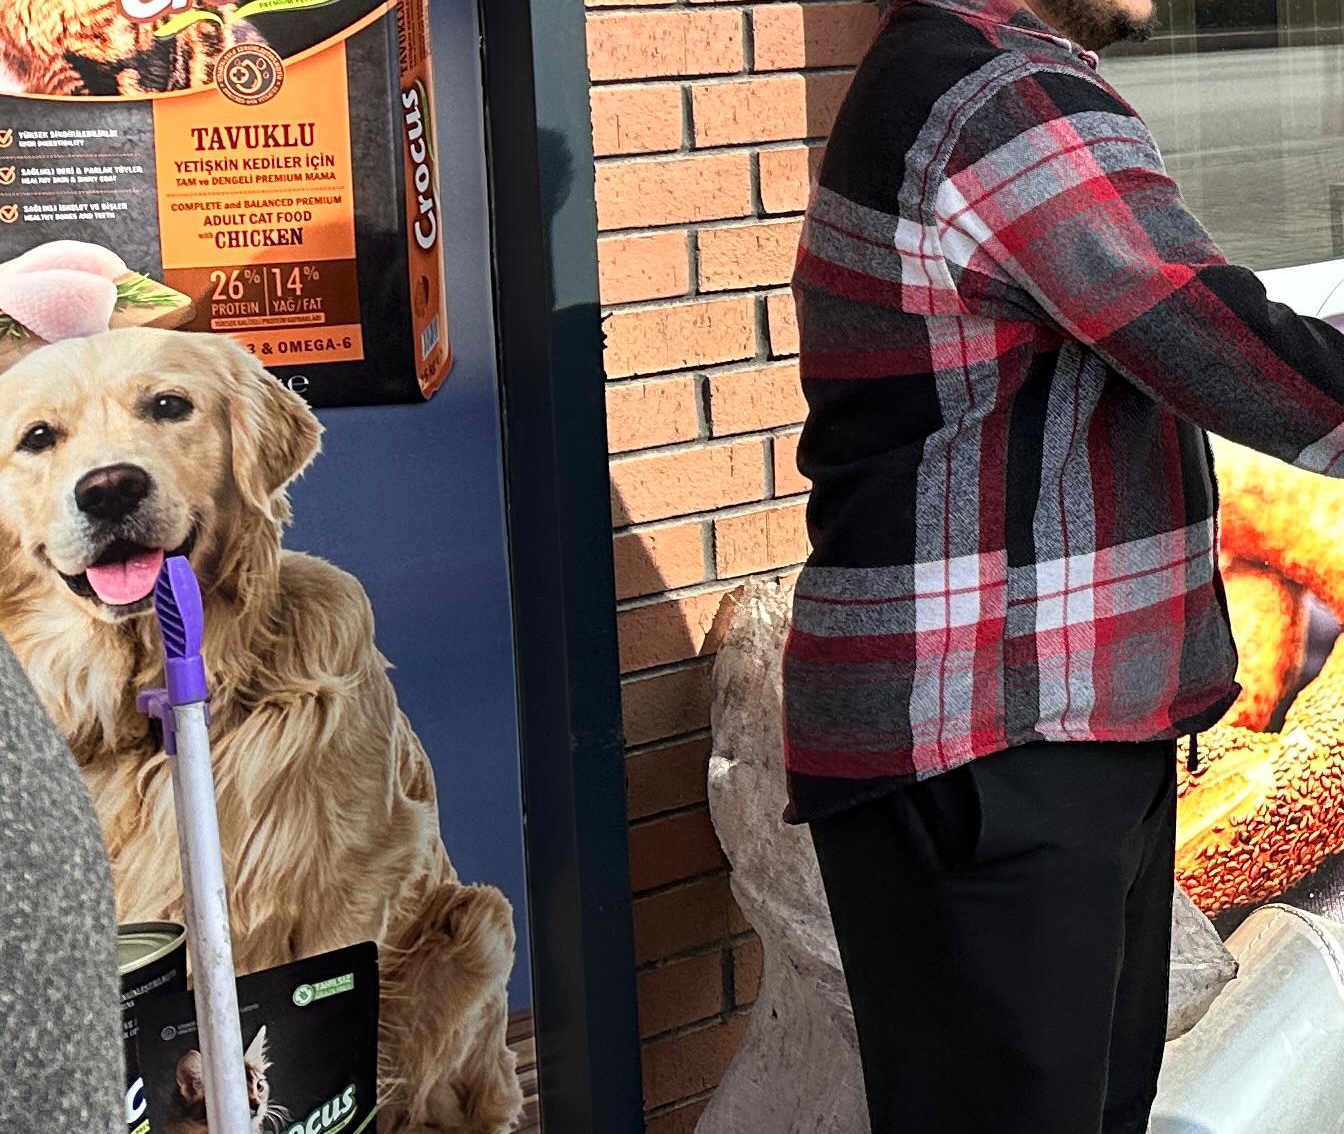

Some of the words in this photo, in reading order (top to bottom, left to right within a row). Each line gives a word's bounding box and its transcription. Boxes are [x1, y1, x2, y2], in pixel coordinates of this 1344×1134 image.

[191, 122, 316, 152] TAVUKLU
[175, 158, 239, 176] YETİŞKİN
[243, 154, 302, 171] KEDİLER
[306, 151, 336, 171] İÇİN
[402, 88, 437, 252] Crocus
[176, 178, 197, 187] TAM
[212, 175, 253, 186] DENGELİ
[255, 173, 303, 184] PREMIUM
[305, 171, 337, 181] MAMA
[171, 201, 222, 212] COMPLETE
[244, 198, 293, 209] BALANCED
[296, 196, 343, 206] PREMIUM
[203, 213, 246, 227] ADULT
[249, 212, 274, 225] CAT
[277, 210, 312, 223] FOOD
[215, 227, 304, 249] CHICKEN
[211, 301, 260, 316] PROTEIN
[261, 342, 273, 355] &
[278, 336, 353, 354] OMEGA-6
